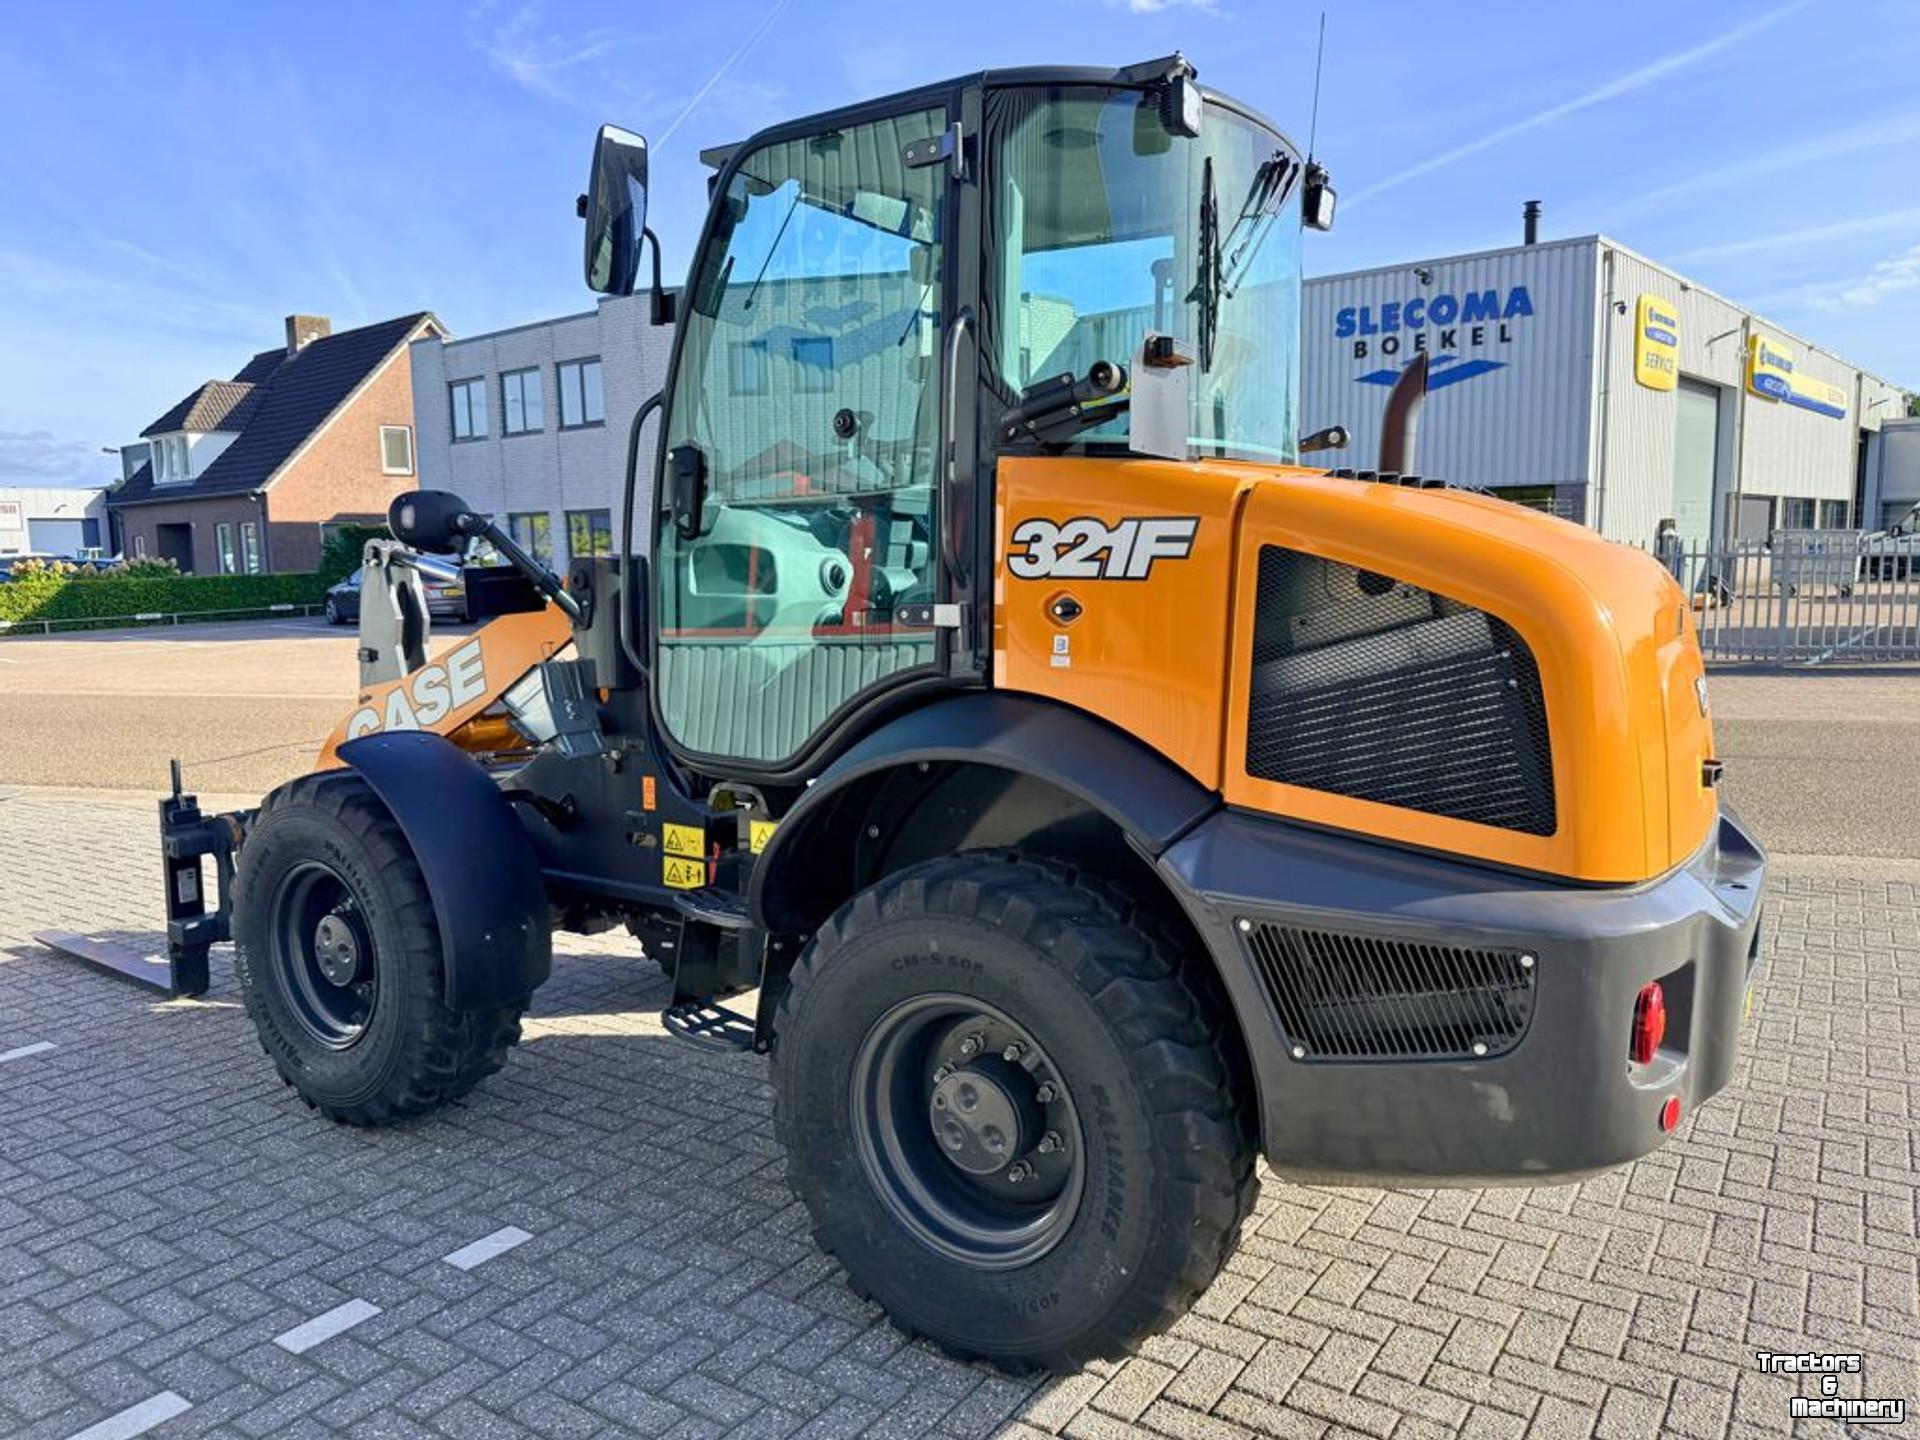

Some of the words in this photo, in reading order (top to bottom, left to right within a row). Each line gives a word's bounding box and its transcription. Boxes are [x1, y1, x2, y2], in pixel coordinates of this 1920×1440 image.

[1335, 286, 1533, 337] SLECOMA
[1354, 324, 1512, 359] BOEKEL
[1008, 516, 1200, 580] 321F
[346, 638, 488, 741] CASE
